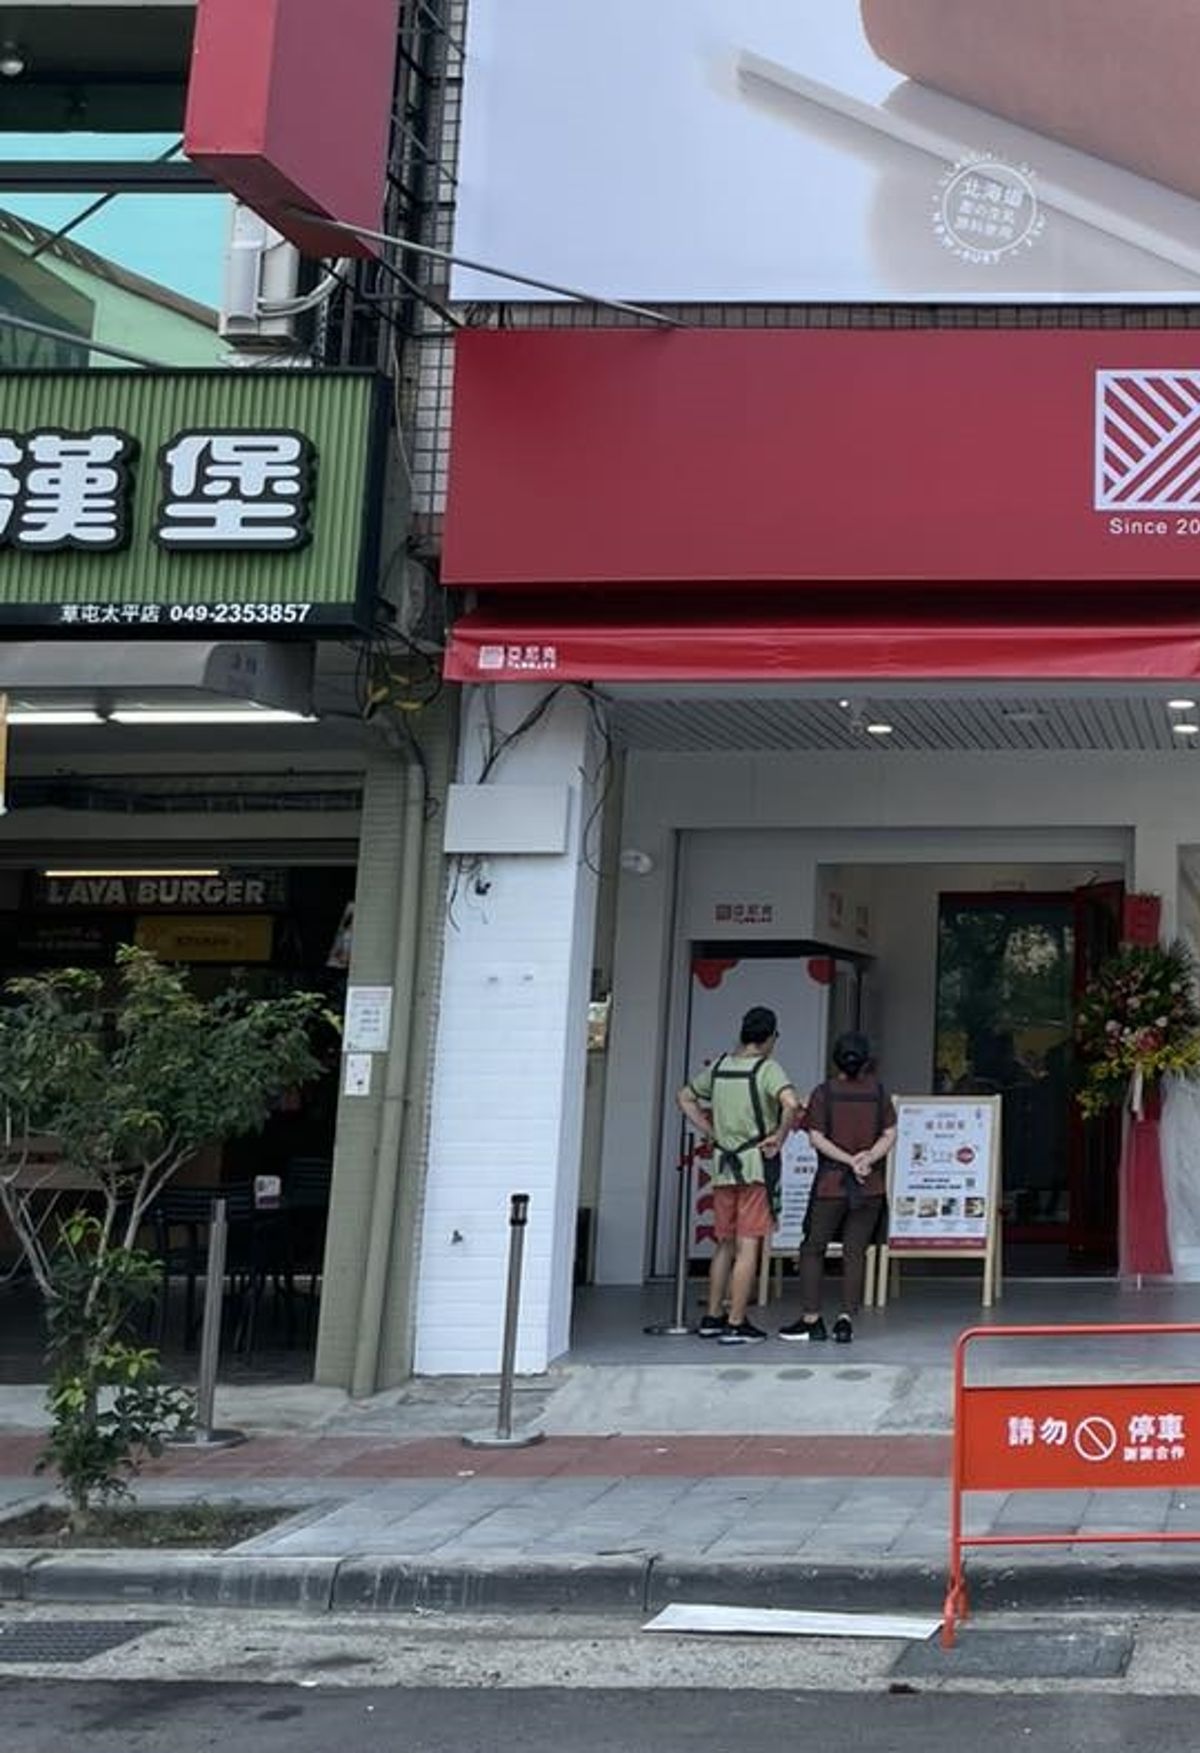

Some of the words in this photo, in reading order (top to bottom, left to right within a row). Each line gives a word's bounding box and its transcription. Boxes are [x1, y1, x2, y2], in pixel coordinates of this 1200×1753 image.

[0, 434, 301, 542] 漢堡
[1109, 517, 1168, 534] Since
[60, 604, 160, 623] 草屯太平店
[169, 603, 311, 624] 049-2353857
[49, 880, 126, 904] LAYA
[137, 879, 265, 904] BURGER
[1008, 1416, 1067, 1446] 請勿
[1128, 1413, 1185, 1443] 停車
